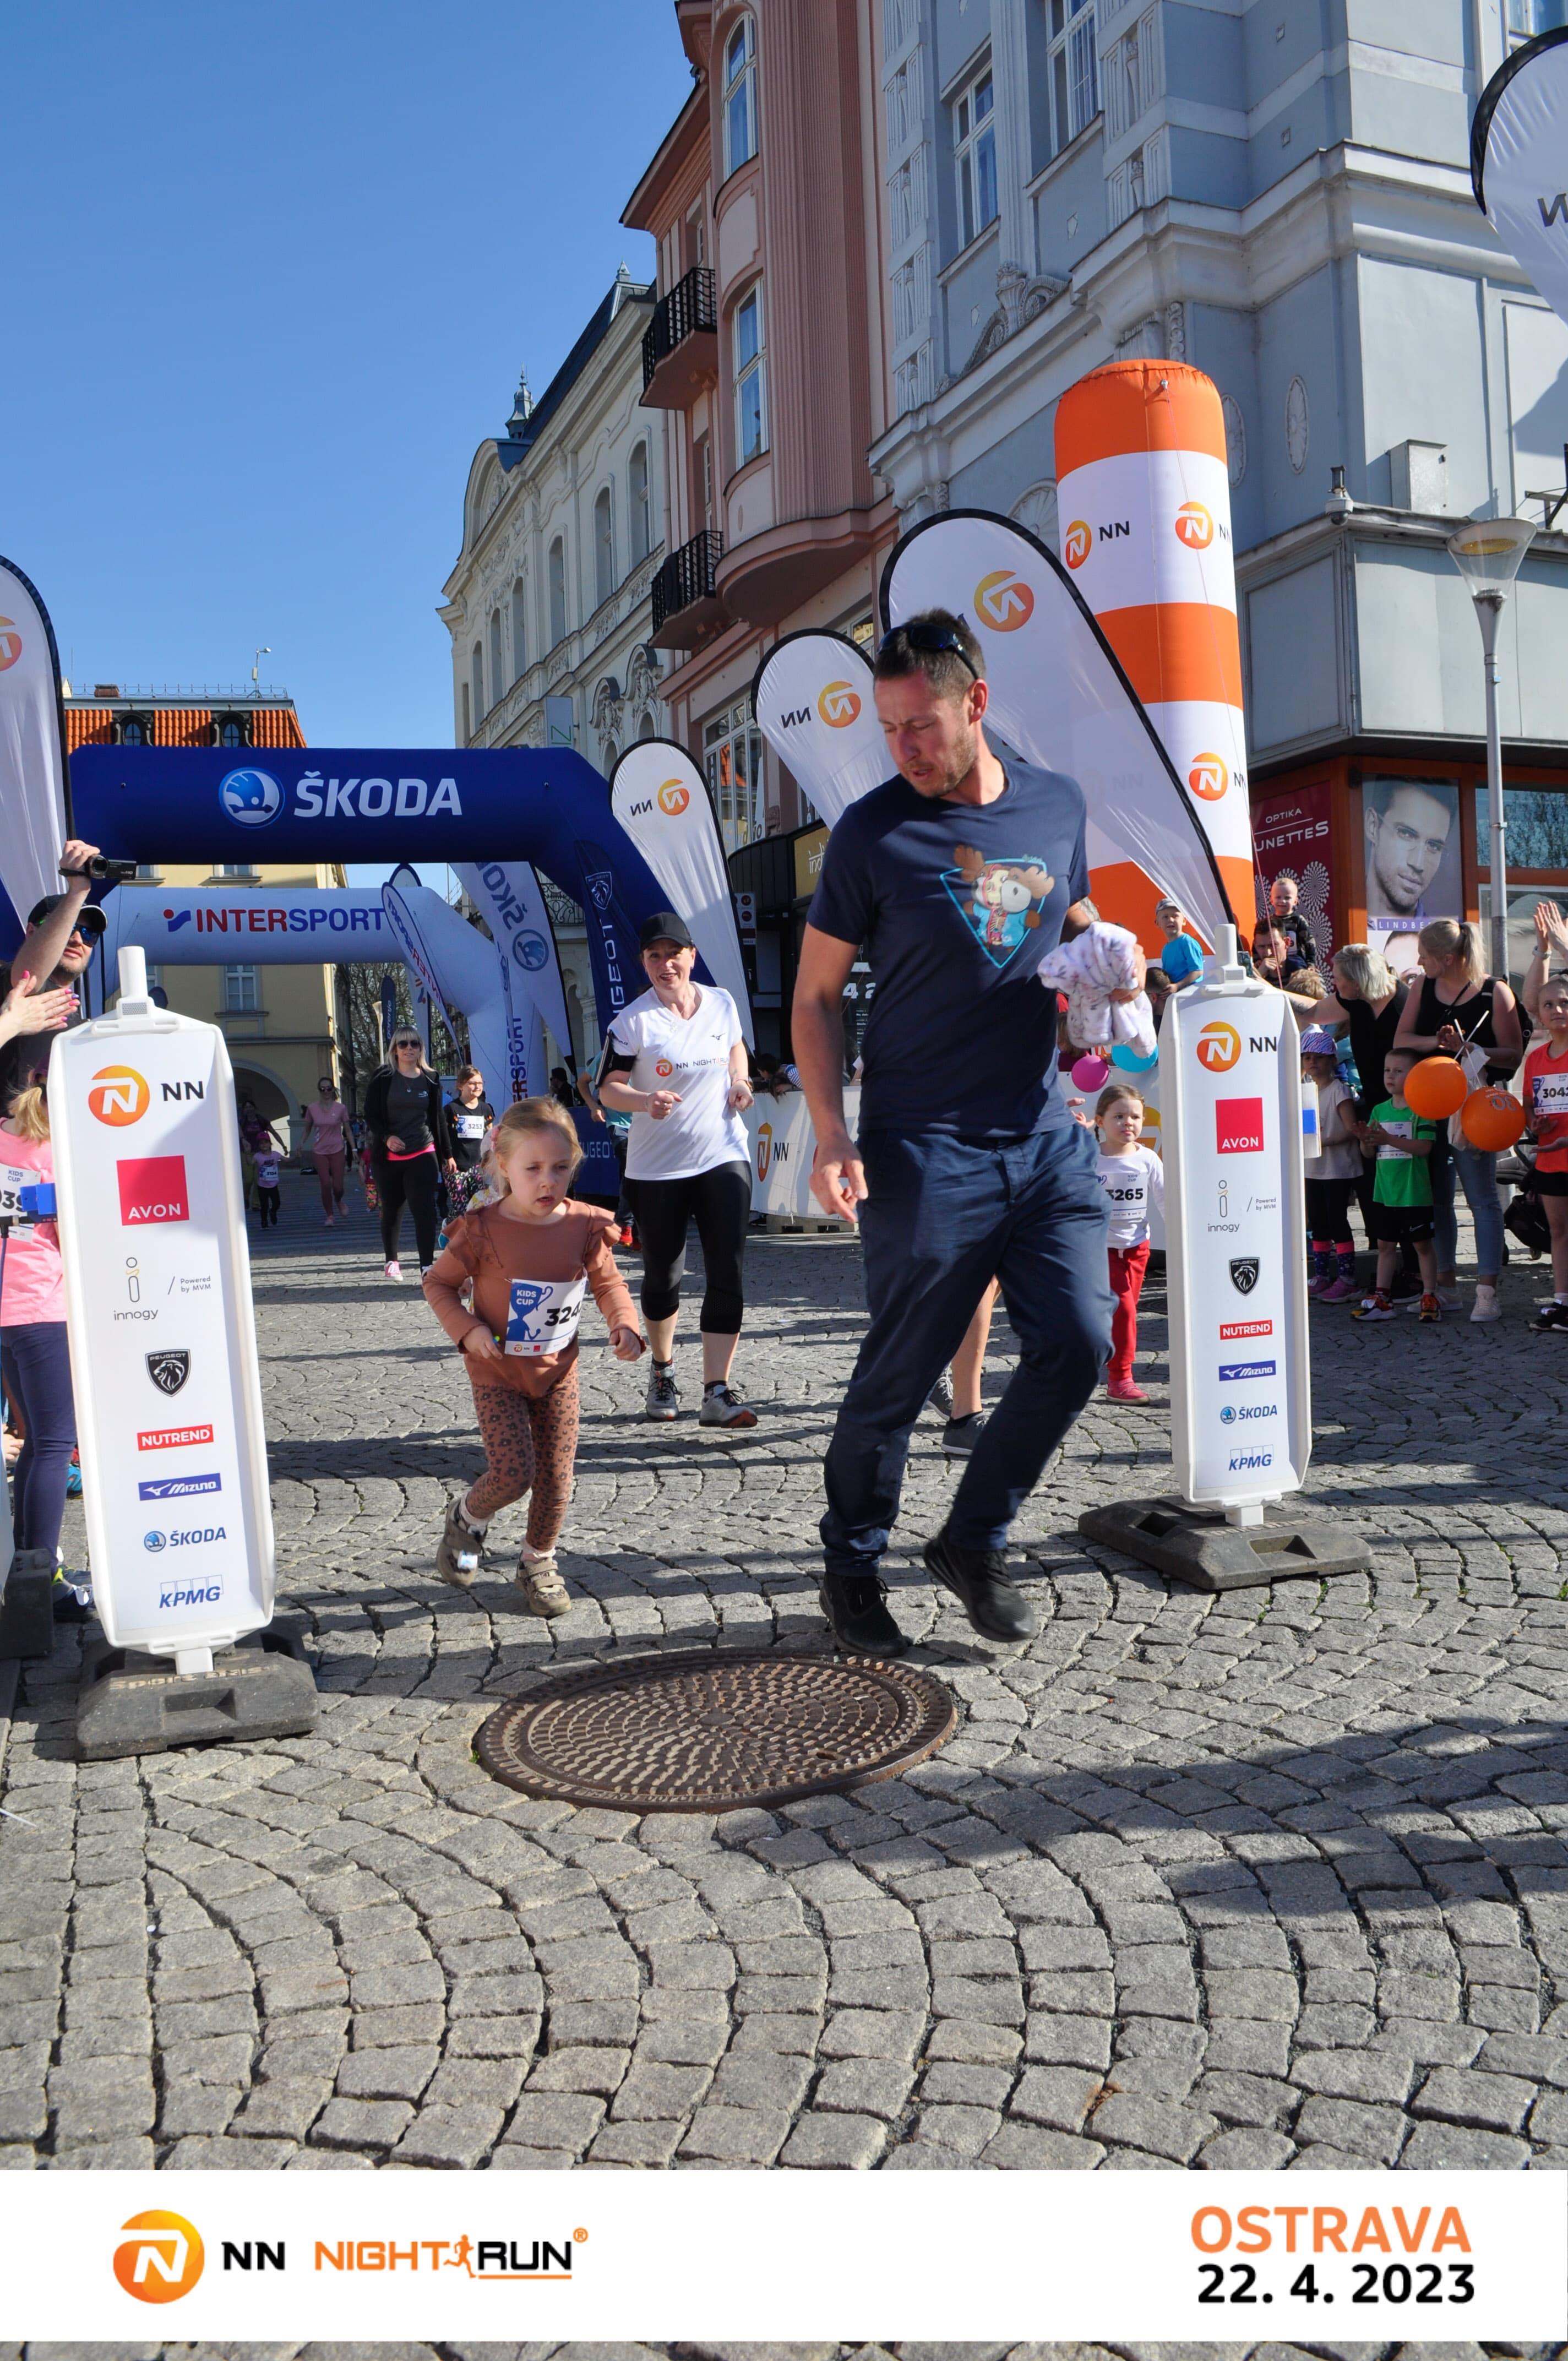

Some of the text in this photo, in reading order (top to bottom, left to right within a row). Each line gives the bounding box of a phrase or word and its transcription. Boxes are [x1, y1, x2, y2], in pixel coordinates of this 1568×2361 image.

[1098, 520, 1130, 541] NN
[293, 770, 463, 818] ŠKODA
[1265, 807, 1303, 824] OPTIKA
[196, 907, 385, 933] INTERSPORT
[1379, 921, 1431, 930] LINDBE
[600, 918, 625, 1014] GEOT
[1249, 1036, 1277, 1053] NN
[160, 1080, 204, 1102] NN
[579, 1141, 616, 1159] UGEO
[1221, 1136, 1259, 1149] AVON
[773, 1142, 789, 1161] NN
[127, 1203, 182, 1220] AVON
[1207, 1223, 1240, 1233] innogy
[179, 1275, 211, 1285] Powered
[181, 1285, 190, 1293] by
[516, 1289, 537, 1298] KIDS
[113, 1309, 159, 1321] innogy
[1222, 1323, 1271, 1337] NUTREND
[149, 1352, 187, 1361] PEUGEOT
[1238, 1405, 1278, 1420] ŠKODA
[141, 1428, 211, 1448] NUTREND
[1228, 1453, 1272, 1471] KPMG
[170, 1526, 227, 1547] ŠKODA
[159, 1585, 221, 1609] KPMG
